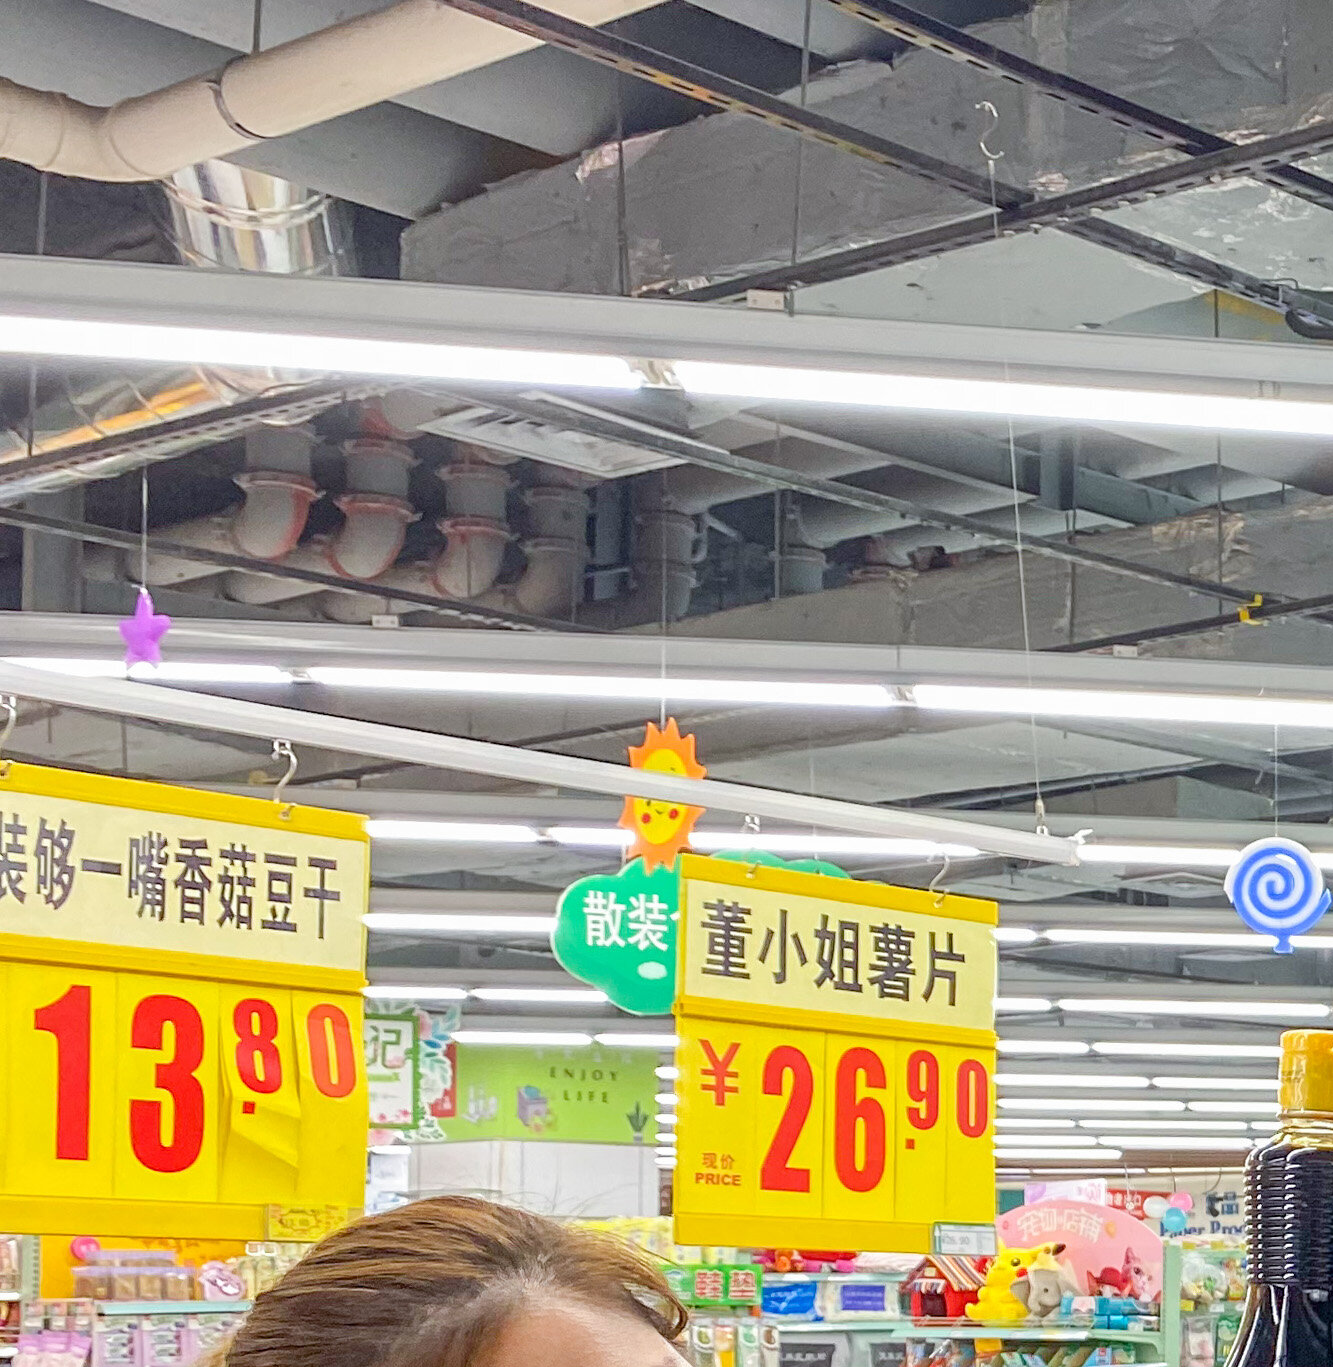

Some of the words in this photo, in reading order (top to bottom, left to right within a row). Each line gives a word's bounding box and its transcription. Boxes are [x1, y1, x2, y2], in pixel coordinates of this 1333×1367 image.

[583, 891, 678, 952] 散装
[700, 899, 966, 1006] 董小姐薯片
[34, 984, 356, 1173] 13.80
[550, 1066, 619, 1081] ENJOY
[563, 1090, 609, 1104] LIFE
[760, 1045, 989, 1195] 26.90
[695, 1172, 742, 1187] PRICE
